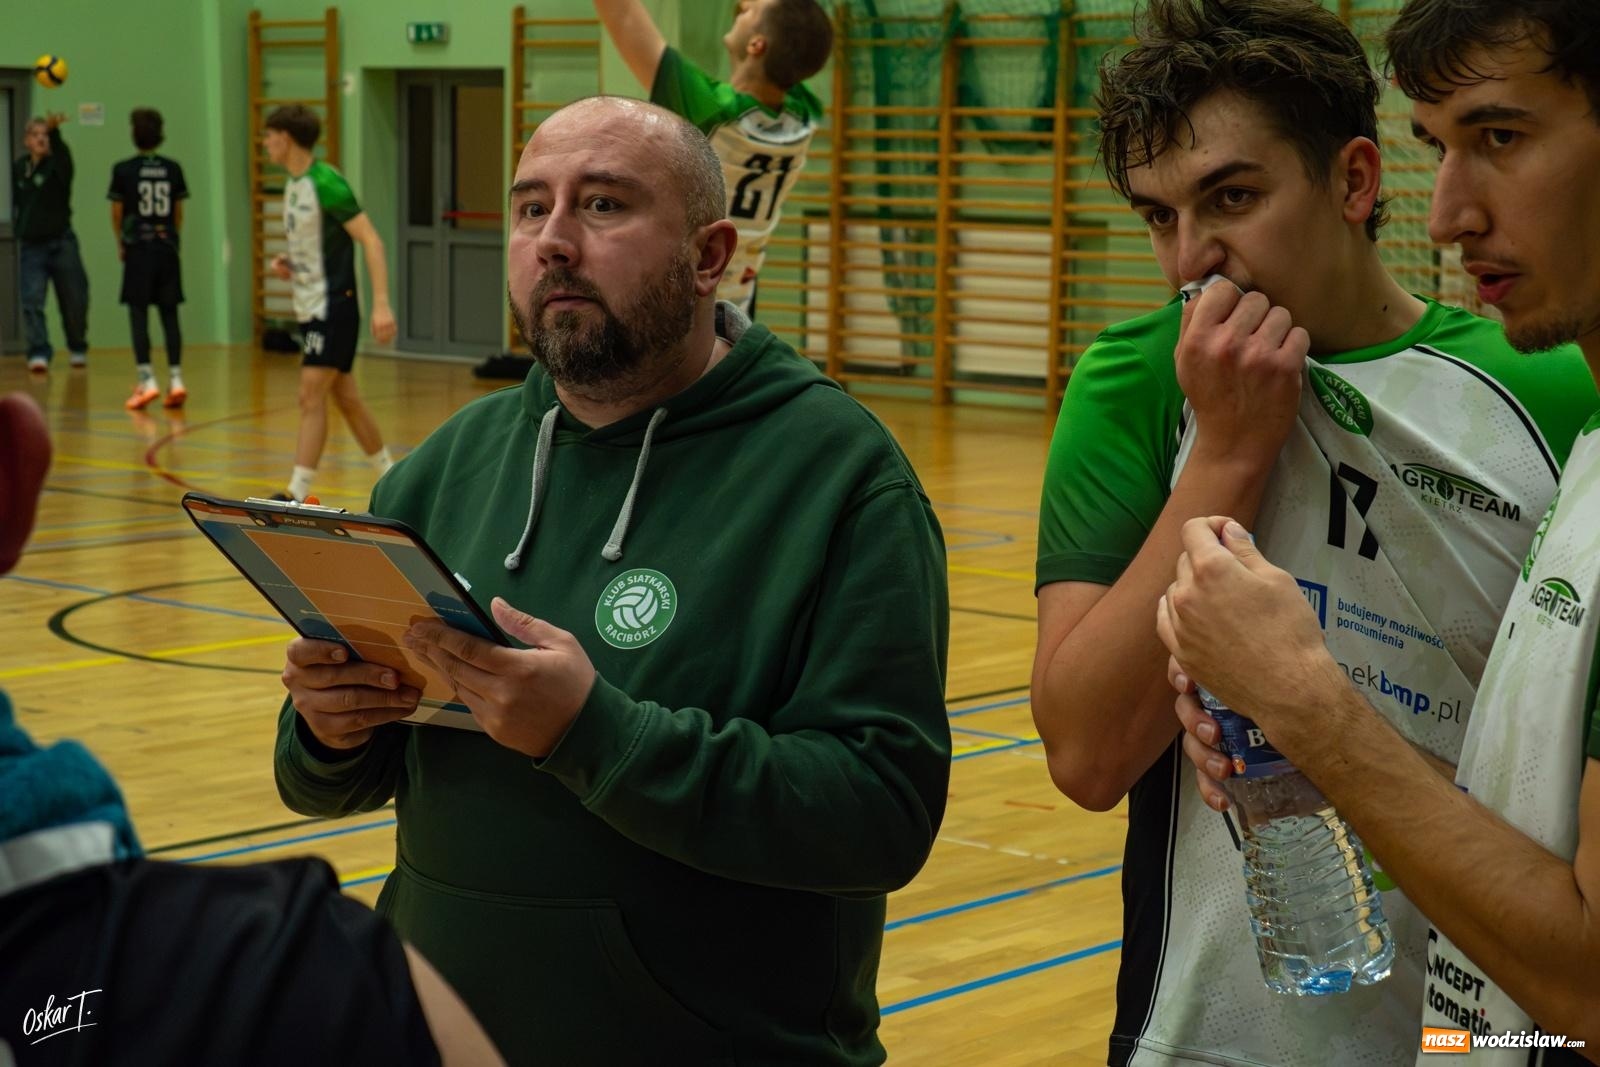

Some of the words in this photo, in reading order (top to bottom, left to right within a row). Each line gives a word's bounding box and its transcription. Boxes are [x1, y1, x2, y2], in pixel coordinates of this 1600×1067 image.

[138, 181, 171, 216] 35
[729, 153, 795, 220] 21
[1325, 453, 1378, 561] 17
[1421, 493, 1462, 514] KIETRZ
[604, 580, 627, 607] KLUB
[626, 574, 671, 610] SIATKARSKI
[1337, 598, 1387, 627] budujemy
[605, 624, 657, 643] RACIBÓRZ
[1337, 616, 1405, 649] porozumienia
[1428, 982, 1492, 1036] tomatic
